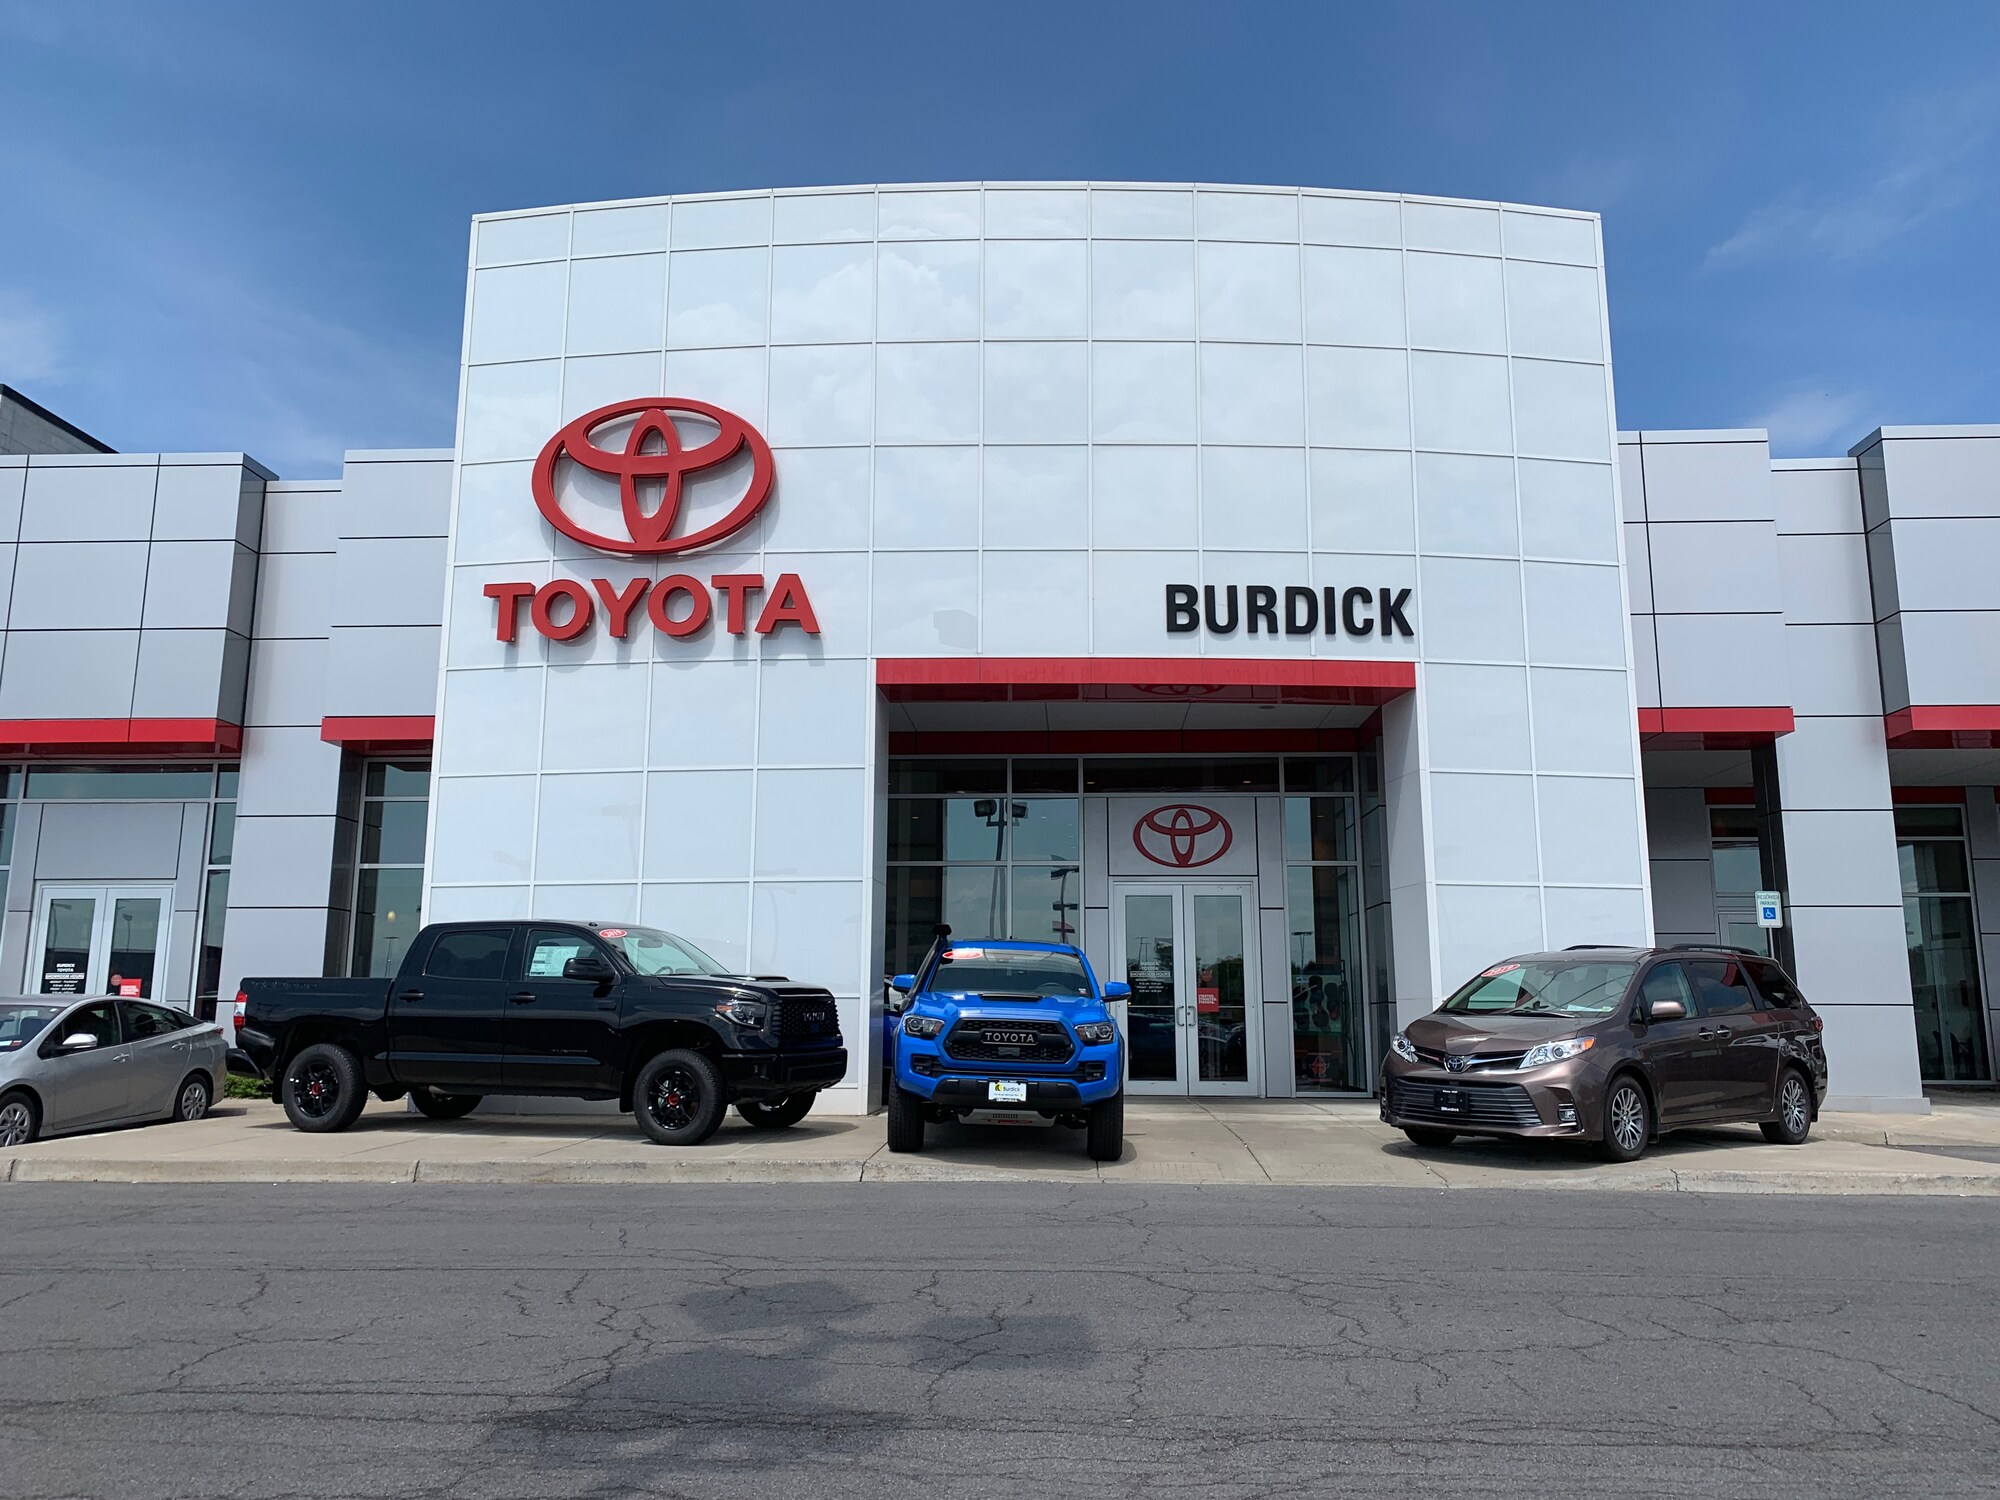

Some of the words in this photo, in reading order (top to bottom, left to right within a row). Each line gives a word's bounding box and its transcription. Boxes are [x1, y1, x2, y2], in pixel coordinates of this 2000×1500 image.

[484, 573, 819, 641] TOYOTA
[1166, 584, 1415, 637] BURDICK
[985, 1033, 1035, 1043] TOYOTA
